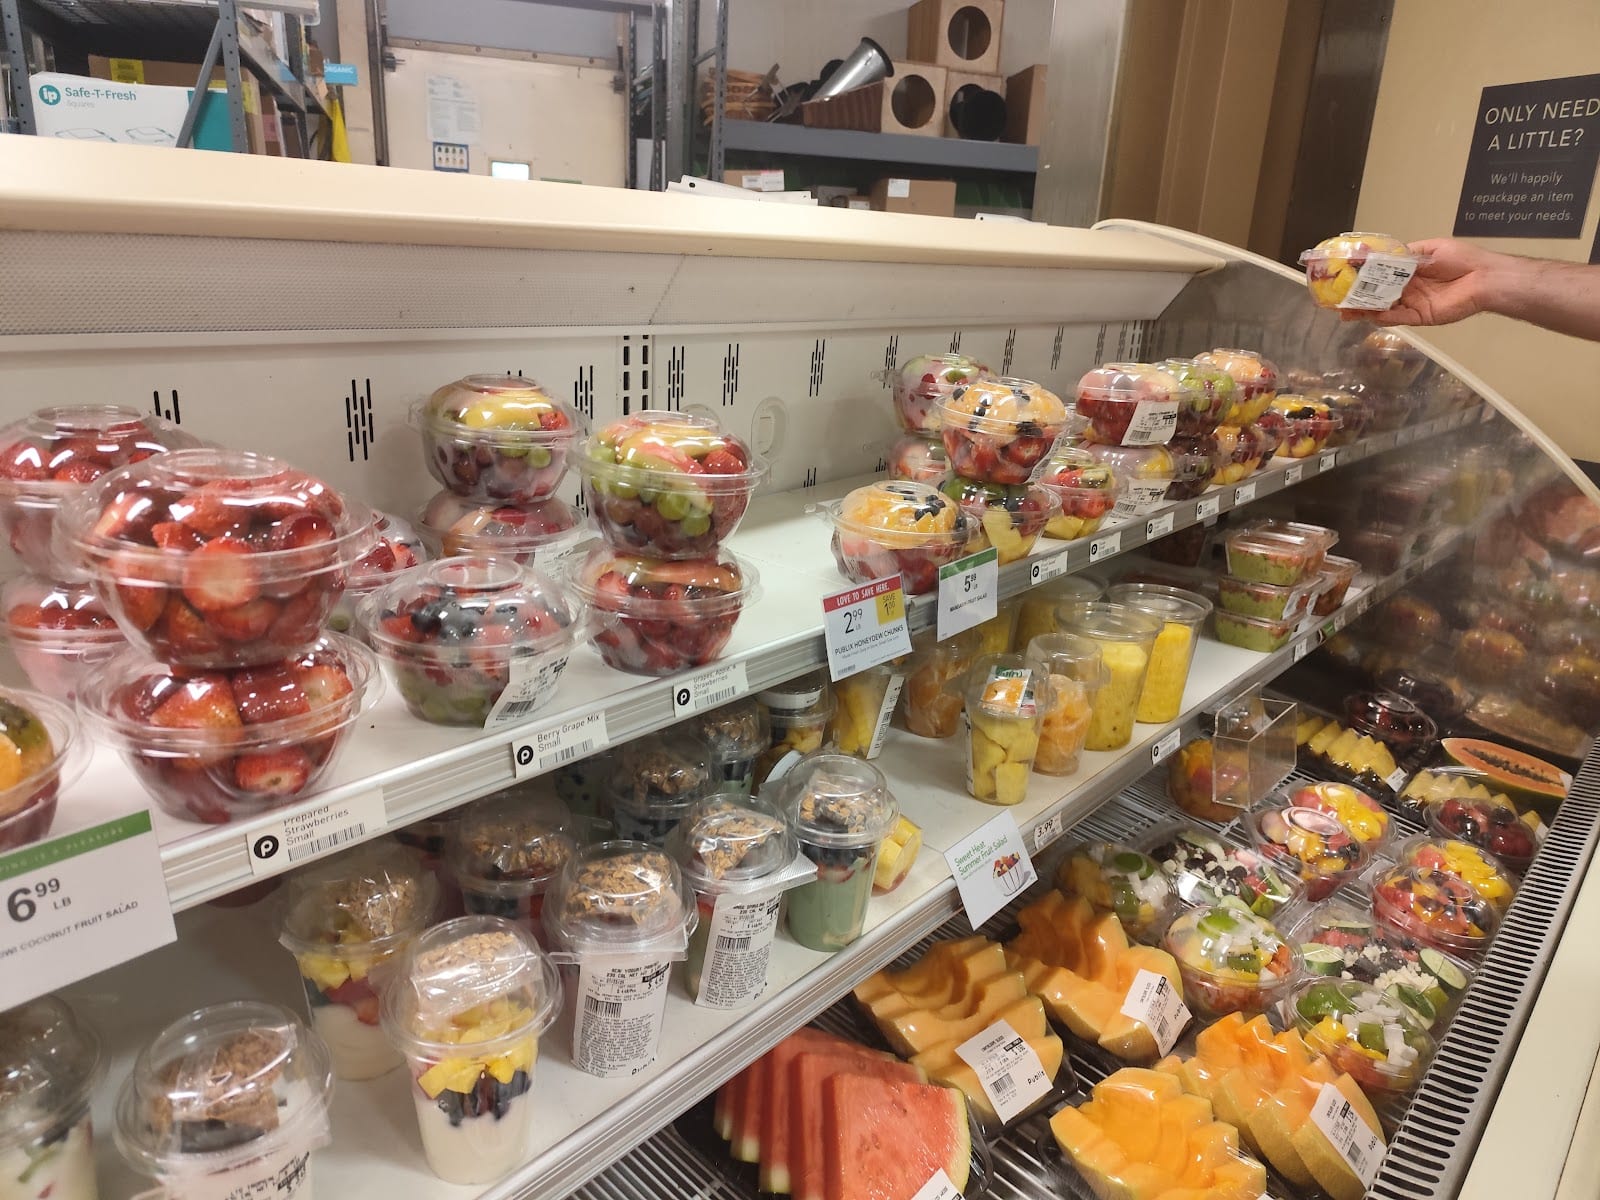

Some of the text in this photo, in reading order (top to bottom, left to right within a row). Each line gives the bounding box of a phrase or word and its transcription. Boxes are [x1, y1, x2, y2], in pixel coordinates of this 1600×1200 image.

[65, 87, 137, 101] Safe-T-Fresh
[1485, 98, 1600, 125] ONLY NEED
[1487, 128, 1585, 151] A LITTLE?
[1491, 171, 1563, 186] We'll happily
[1473, 191, 1574, 206] repackage an item
[1465, 209, 1574, 224] to meet your needs.
[836, 597, 851, 607] LOVE
[852, 593, 860, 601] TO
[861, 587, 875, 598] SAVE
[883, 593, 897, 602] SAVE
[834, 643, 854, 655] PUBLIX
[854, 631, 884, 648] HONEYDEW
[883, 624, 904, 637] CHUNKS
[537, 713, 600, 743] Berry Grape Mix
[538, 736, 561, 752] Small
[283, 805, 329, 826] Prepared
[284, 809, 350, 836] Strawberries
[286, 830, 315, 846] Small
[1037, 819, 1054, 838] 3.99
[954, 841, 986, 867] Sweet Heat
[959, 857, 982, 876] Summer
[980, 847, 993, 860] Fruit
[992, 834, 1008, 852] Salad
[53, 896, 72, 910] LB
[20, 926, 72, 951] COCONUT
[74, 913, 103, 931] FRUIT
[105, 901, 139, 919] SALAD
